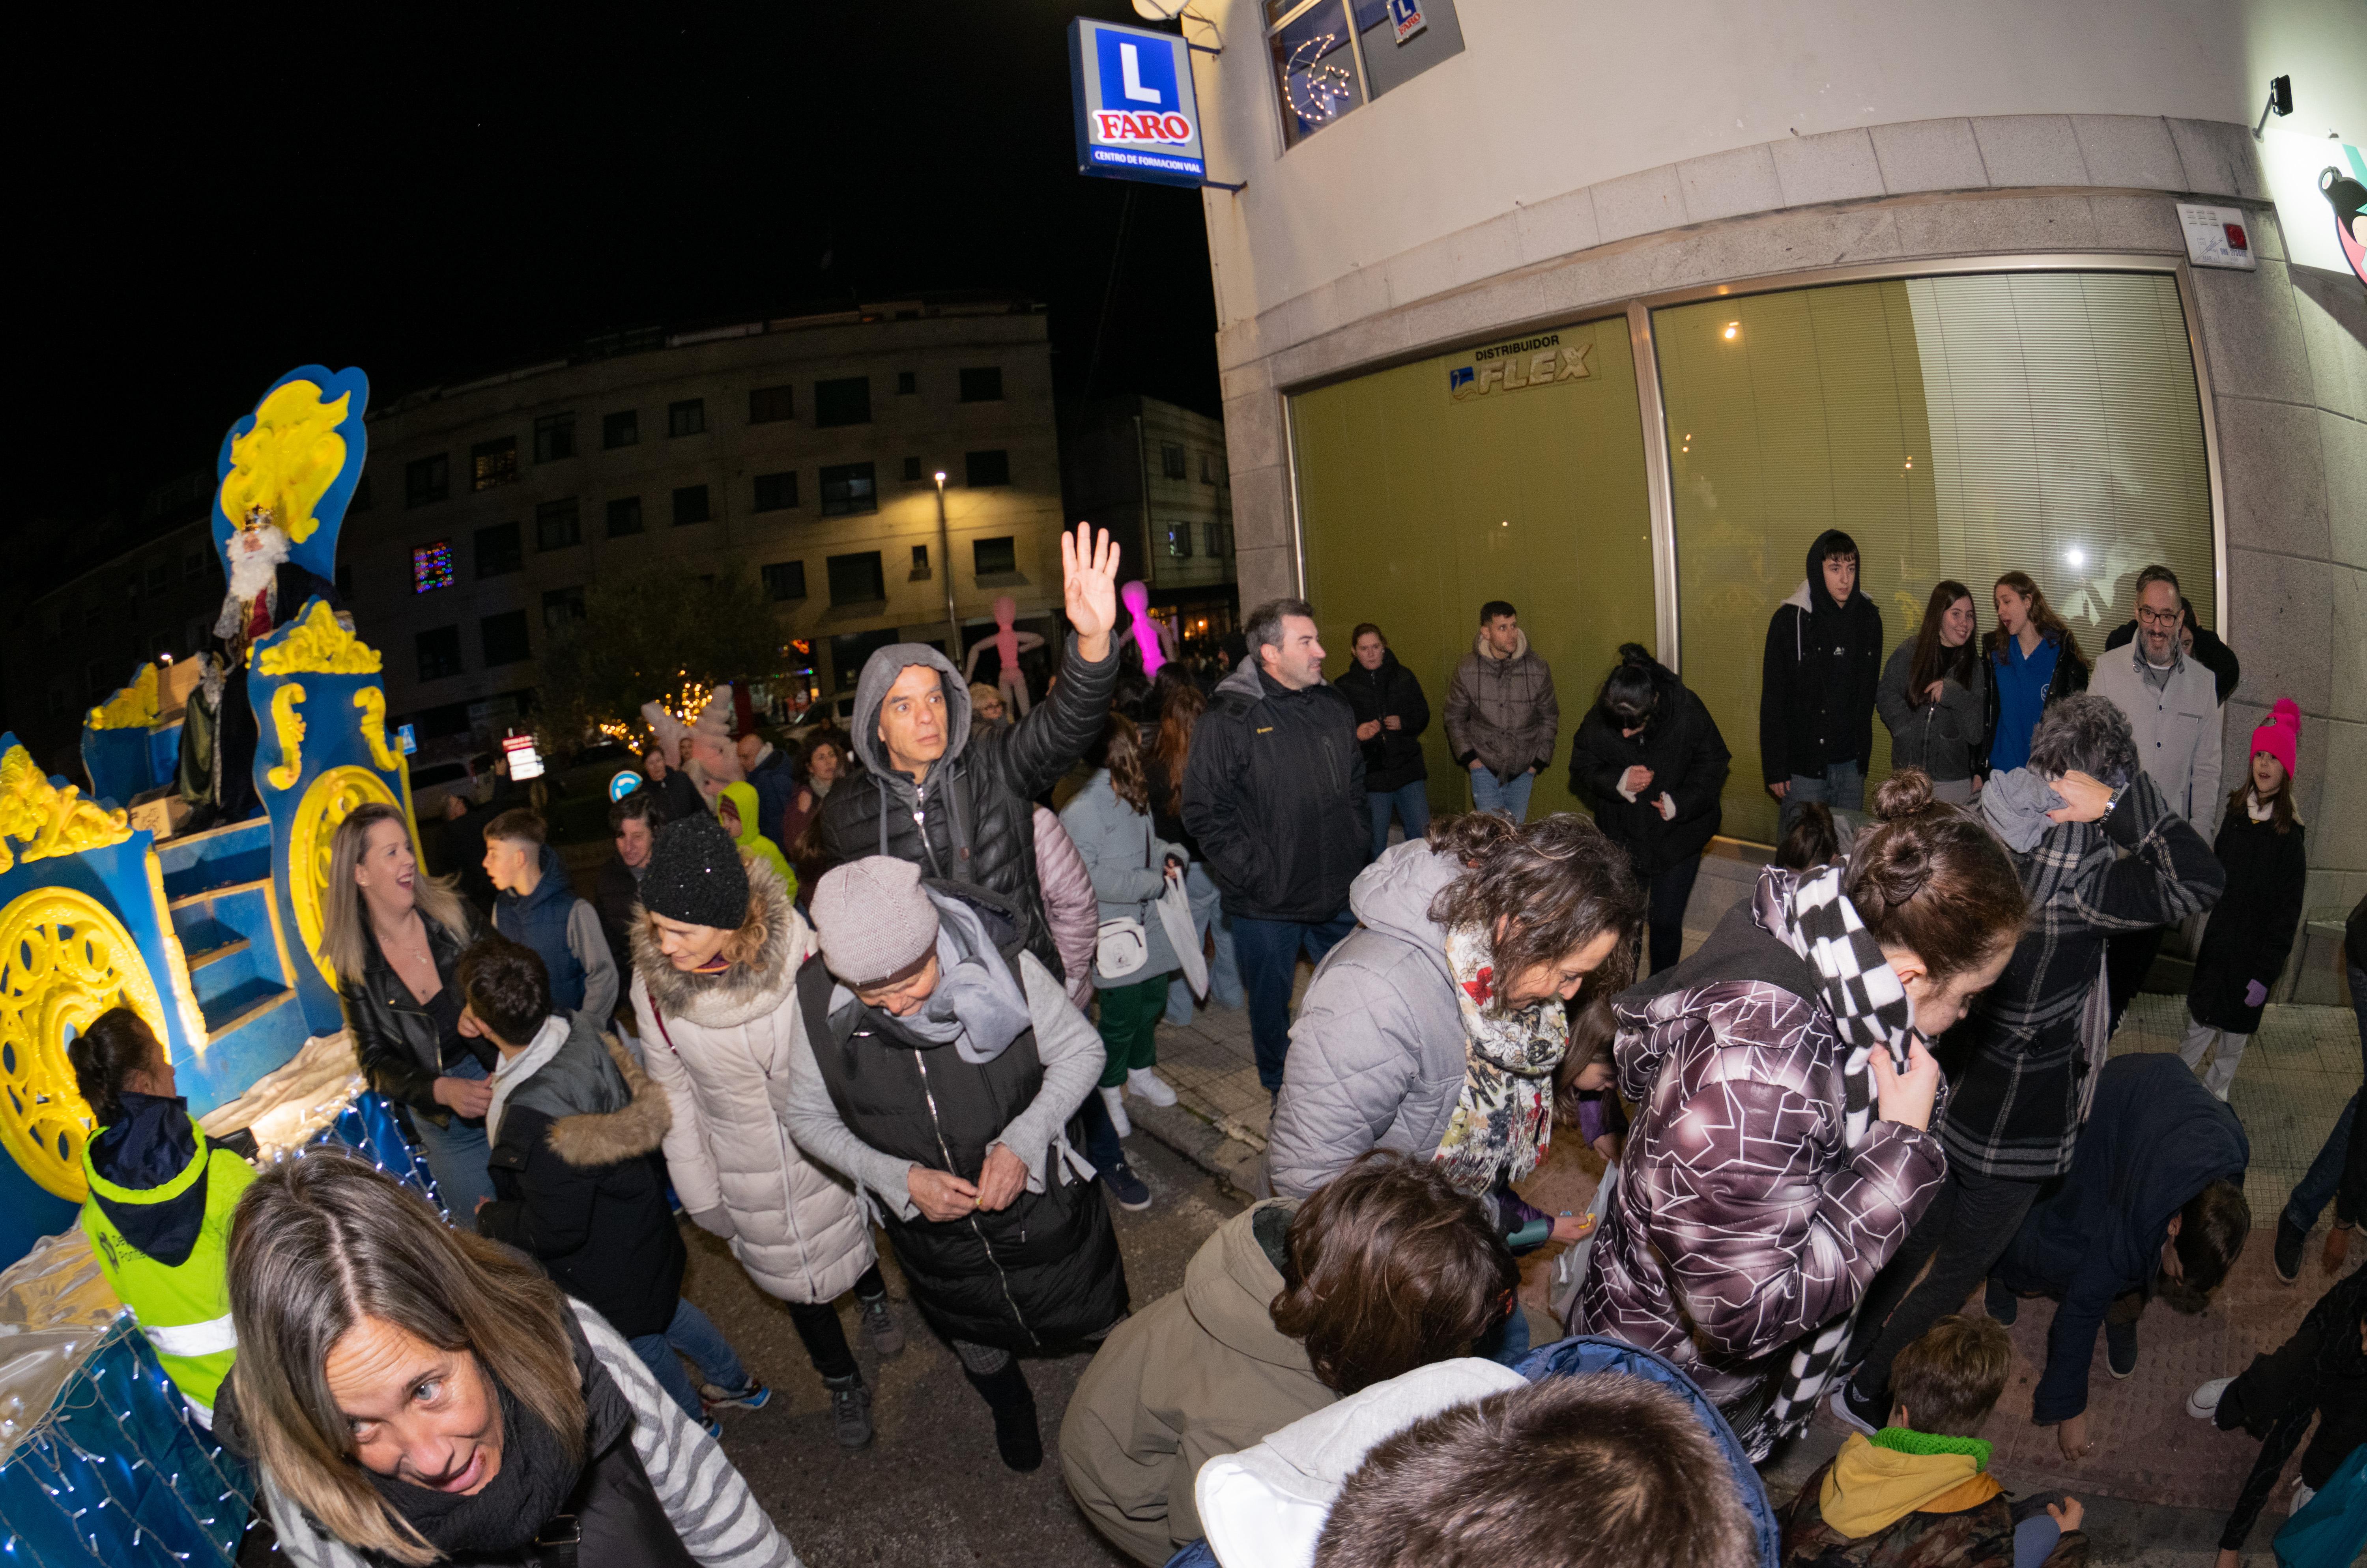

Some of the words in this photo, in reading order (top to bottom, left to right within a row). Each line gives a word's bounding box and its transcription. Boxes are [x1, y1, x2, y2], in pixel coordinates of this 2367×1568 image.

[1398, 0, 1412, 19] L
[1399, 12, 1421, 36] FARO
[1120, 43, 1161, 104] L
[1097, 114, 1190, 140] FARO
[1095, 150, 1126, 163] CENTRO
[1127, 154, 1138, 164] DE
[1138, 155, 1184, 171] FORMACION
[1184, 162, 1202, 173] VIAL
[1475, 335, 1559, 361] DISTRIBUIDOR
[1478, 344, 1593, 395] FLEX
